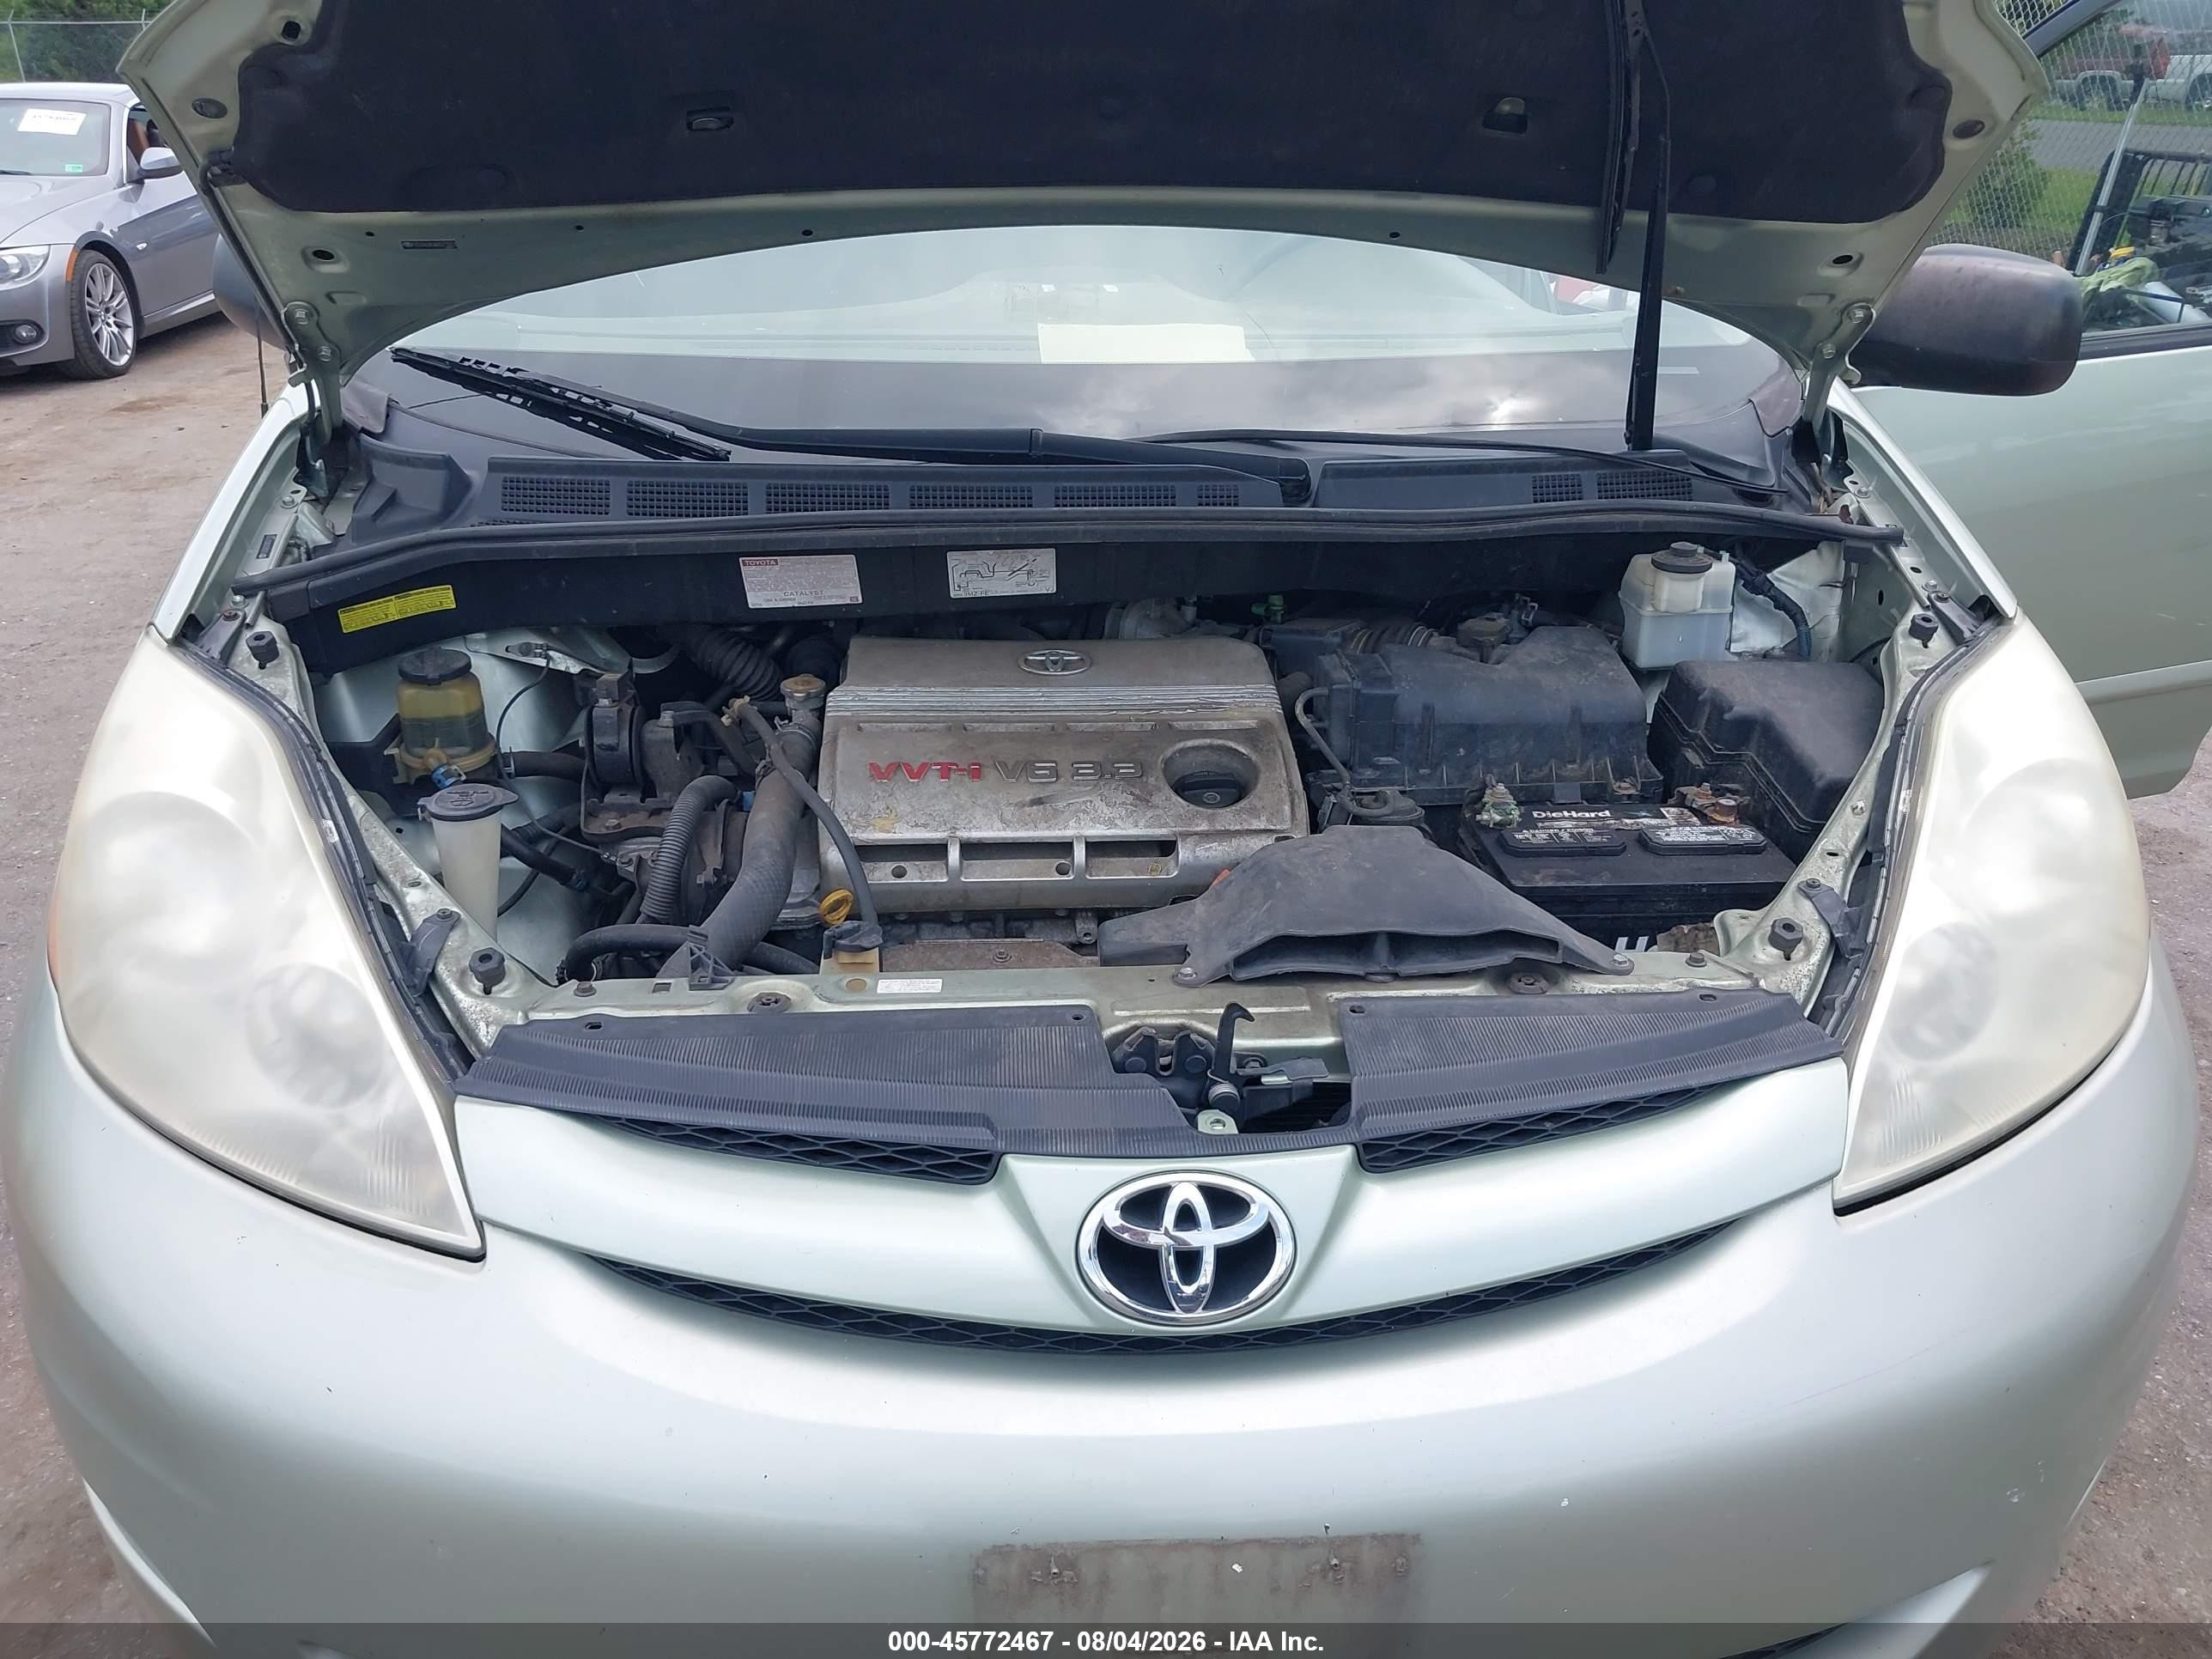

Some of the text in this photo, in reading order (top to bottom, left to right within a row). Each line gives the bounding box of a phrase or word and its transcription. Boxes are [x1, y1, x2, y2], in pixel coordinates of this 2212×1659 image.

[993, 762, 1059, 783] V6
[1072, 762, 1143, 781] 3.3
[1532, 810, 1612, 818] DieHard
